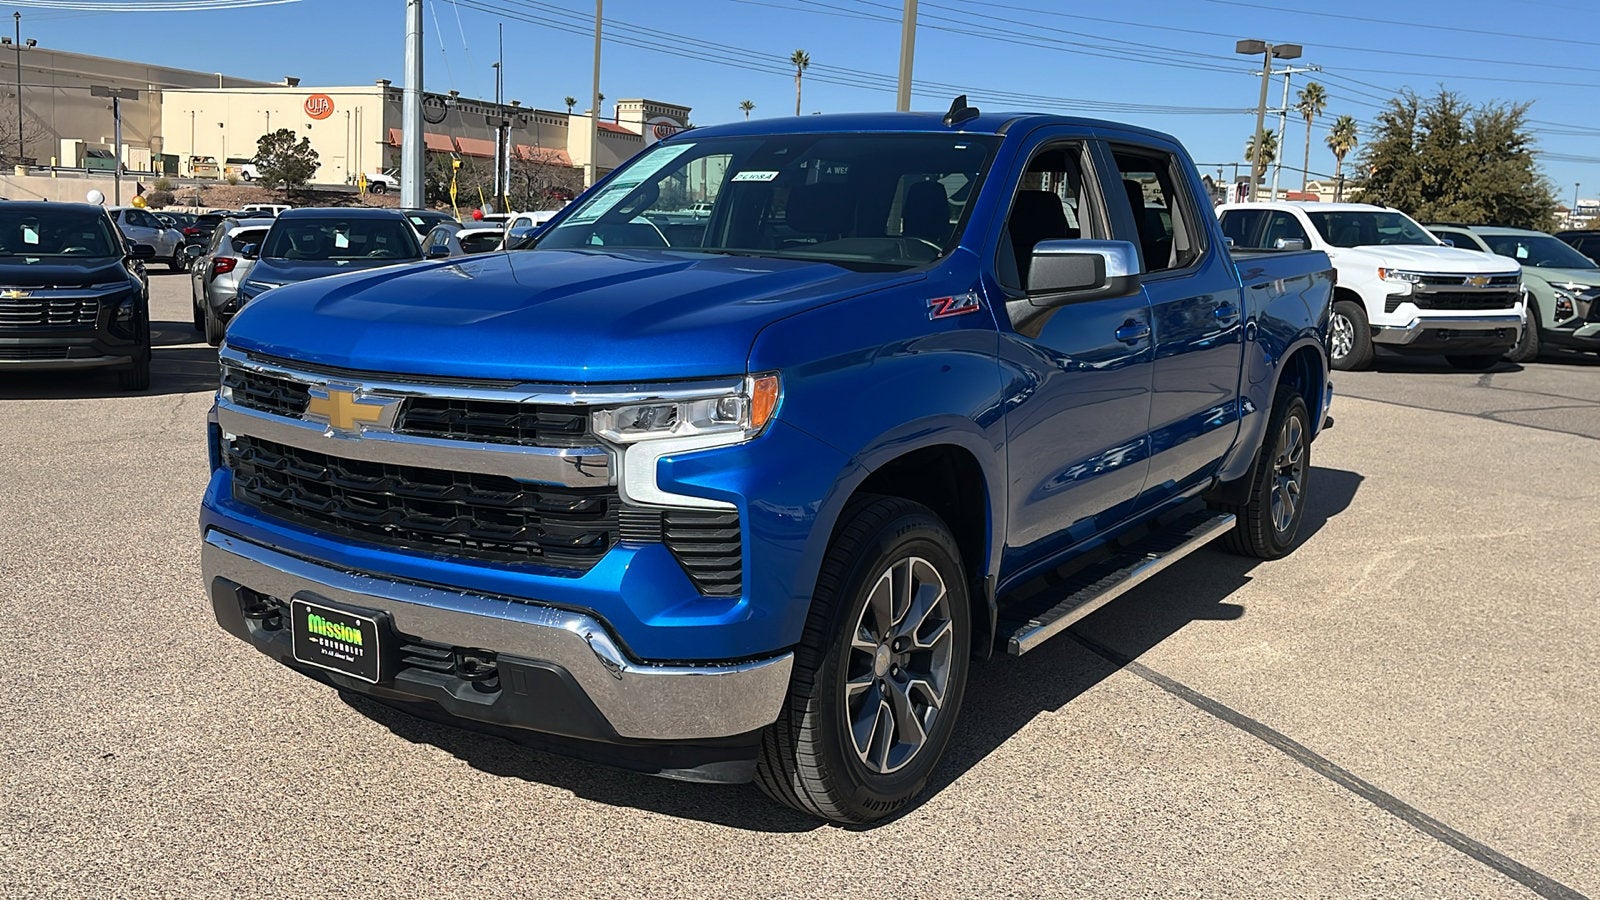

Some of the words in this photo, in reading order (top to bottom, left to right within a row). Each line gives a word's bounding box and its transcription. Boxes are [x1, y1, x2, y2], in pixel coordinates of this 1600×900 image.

[307, 98, 329, 110] ULTA
[926, 292, 980, 320] Z71
[308, 613, 363, 646] Mission
[319, 637, 364, 656] CHEVROLET
[862, 796, 907, 812] SAILUN
